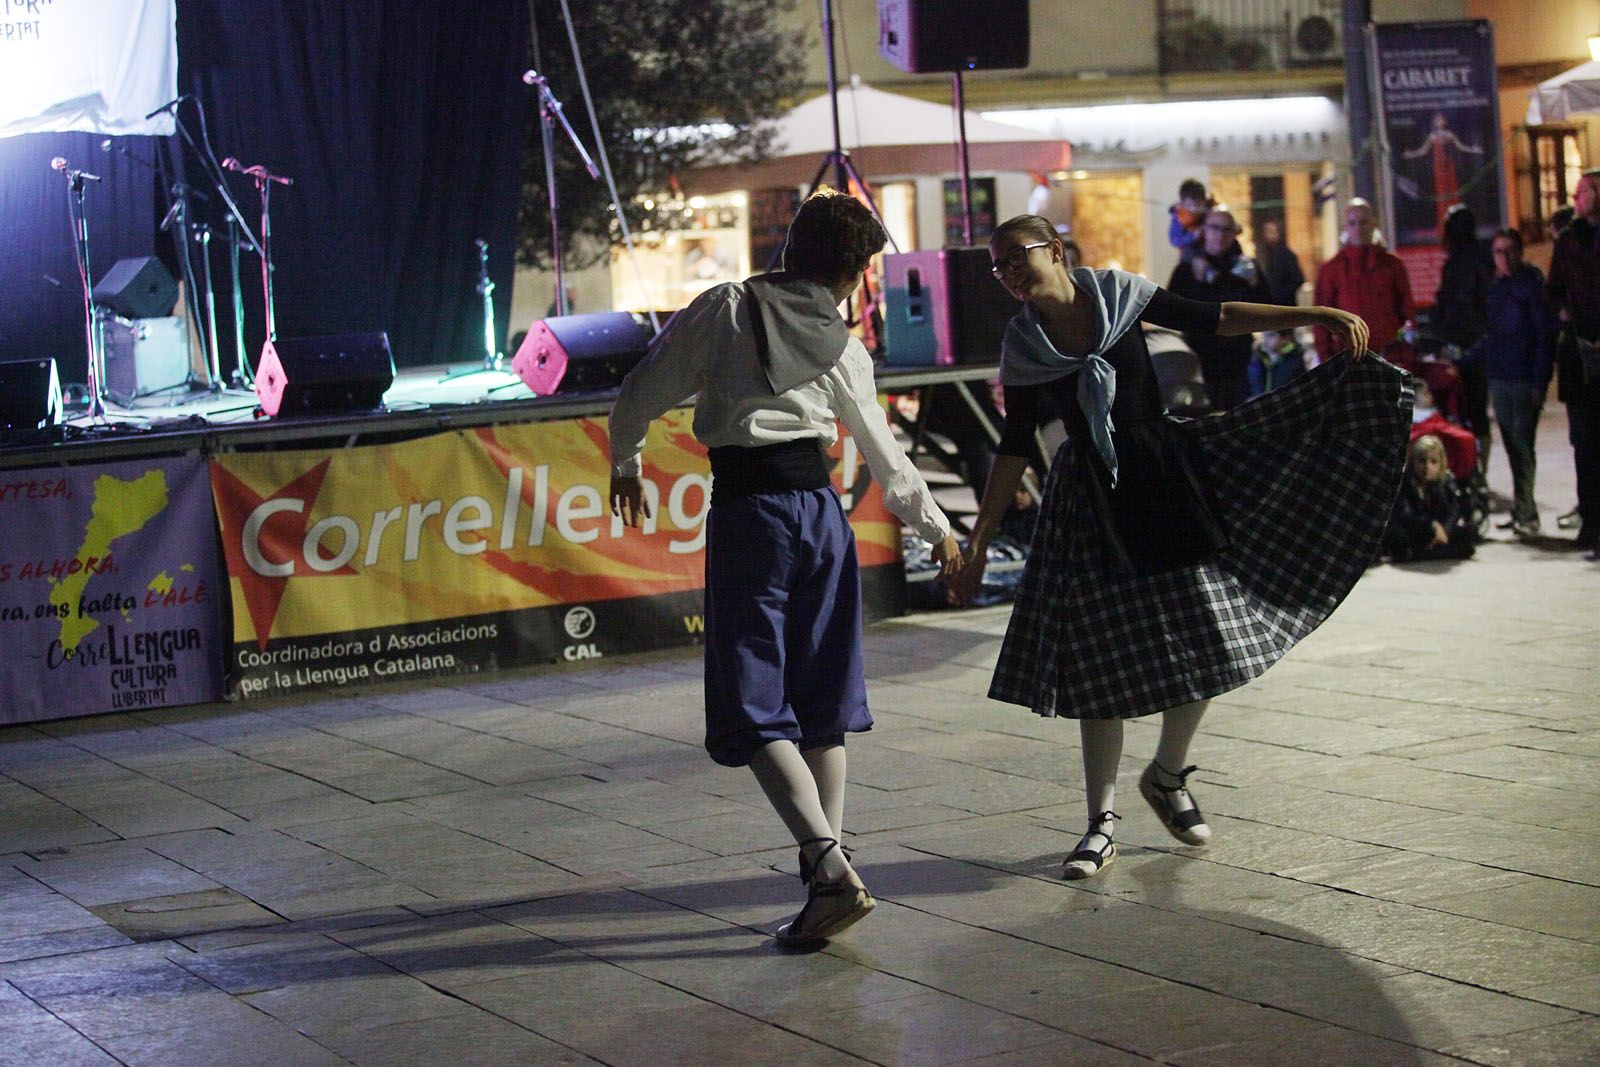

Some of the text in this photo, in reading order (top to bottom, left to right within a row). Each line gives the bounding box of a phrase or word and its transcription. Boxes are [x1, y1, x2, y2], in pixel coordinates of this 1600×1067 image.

[1384, 66, 1472, 90] CABARET
[34, 602, 71, 619] ens
[78, 593, 137, 619] falta
[238, 640, 364, 668] Coordinadora
[563, 644, 602, 661] CAL
[110, 663, 177, 690] CULTURA
[241, 653, 455, 696] per la Llengua Catalana
